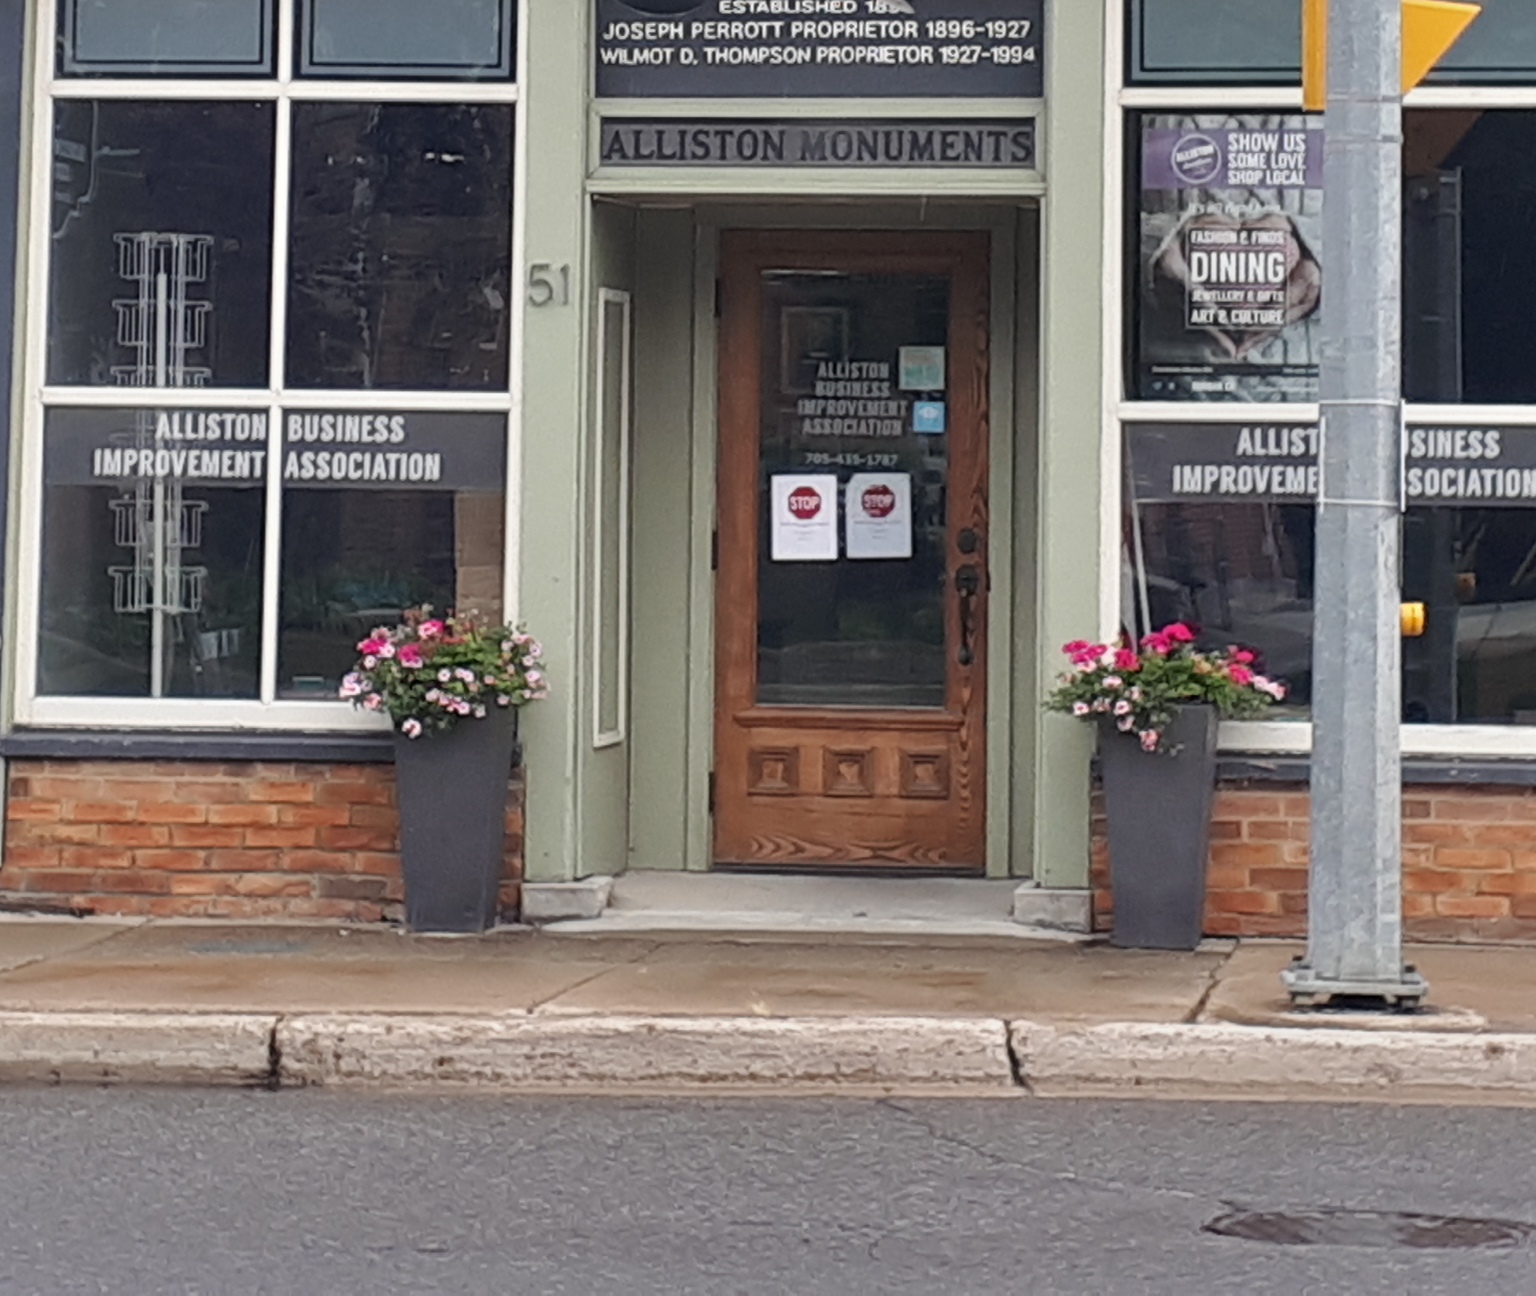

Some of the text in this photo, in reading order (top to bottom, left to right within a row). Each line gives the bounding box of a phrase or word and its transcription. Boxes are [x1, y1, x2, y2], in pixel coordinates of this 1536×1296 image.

[718, 0, 858, 15] ESTABLISHED
[602, 19, 1032, 40] JOSEPH PERROTT PROPRIETOR 1896-1927
[600, 47, 675, 65] WILMOT
[703, 46, 813, 65] THOMPSON
[816, 45, 934, 64] PROPRIETOR
[938, 45, 1036, 64] 1927-1994
[602, 128, 1034, 162] ALLISTON MONUMENTS
[1227, 132, 1307, 153] SHOW US
[1227, 153, 1267, 169] SOME
[1271, 153, 1307, 169] LOVE
[1227, 169, 1306, 185] SHOP LOCAL
[1190, 251, 1285, 283] DINING
[529, 263, 570, 308] 51
[1190, 309, 1215, 324] ART
[1230, 309, 1284, 325] CULTURE
[817, 362, 890, 379] ALLISTON
[815, 380, 891, 398] BUSINESS
[797, 399, 908, 417] IMPROVEMENT
[154, 412, 406, 443] ALLISTON BUSINESS
[802, 417, 903, 436] ASSOCIATION
[1236, 427, 1501, 459] ALLIST SINESS
[93, 448, 442, 482] IMPROVEMENT ASSOCIATION
[1172, 464, 1319, 495] IMPROVEME
[789, 495, 821, 511] STOP
